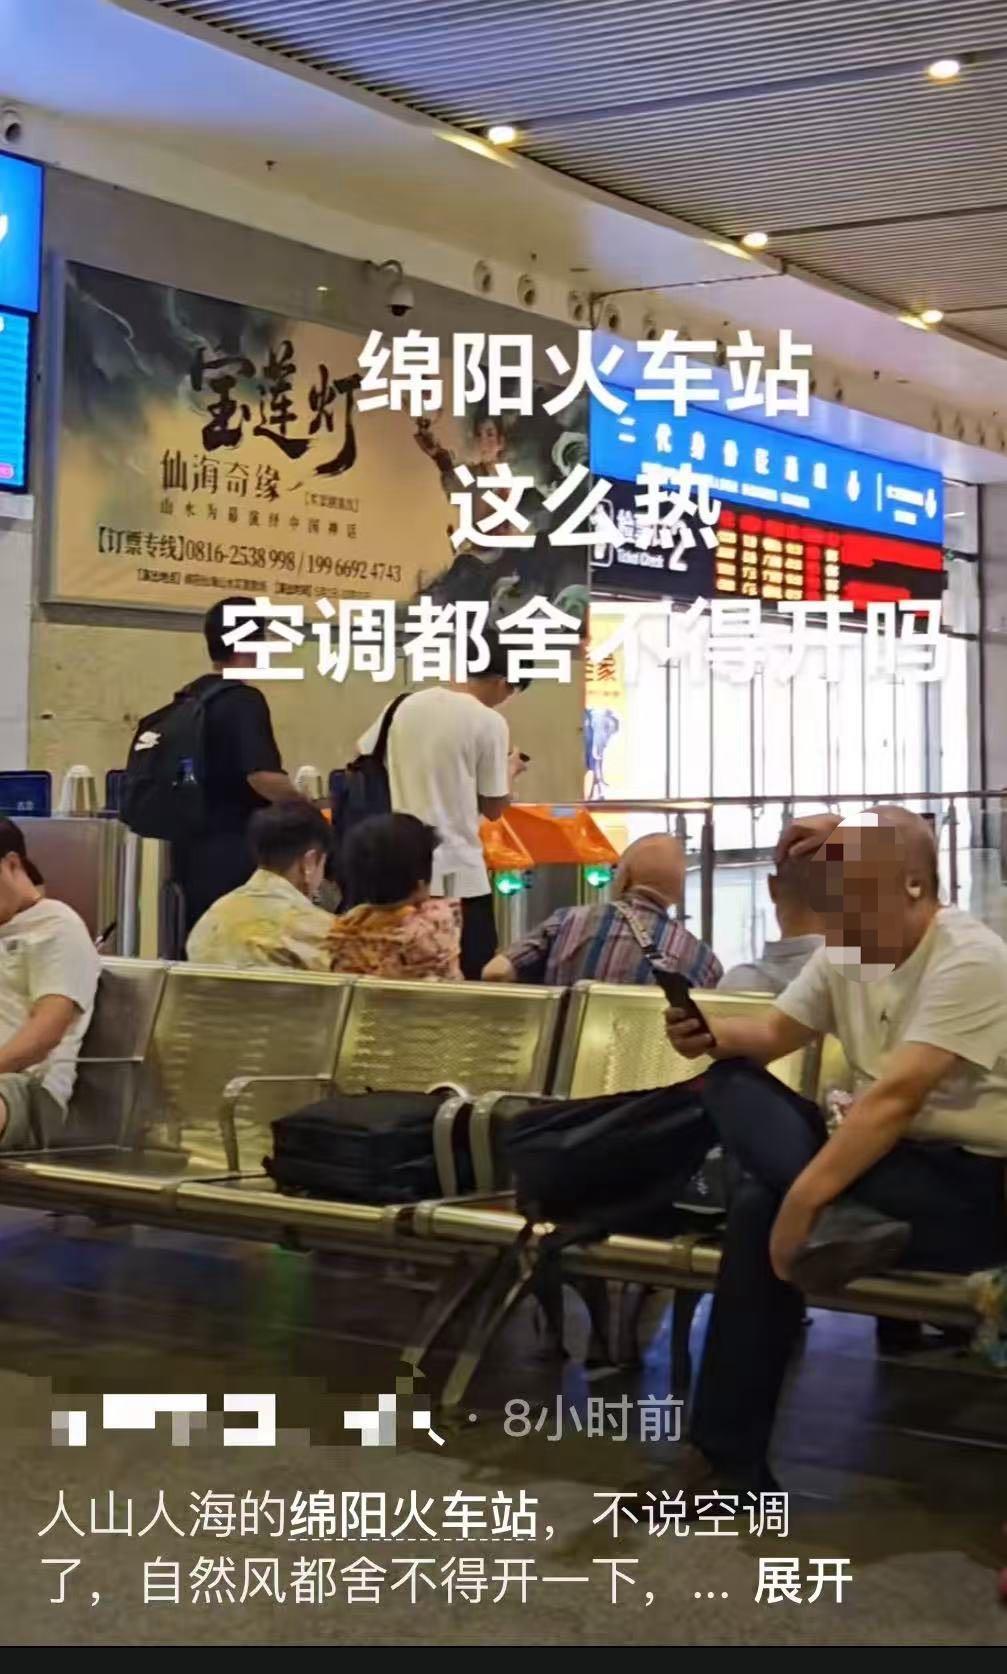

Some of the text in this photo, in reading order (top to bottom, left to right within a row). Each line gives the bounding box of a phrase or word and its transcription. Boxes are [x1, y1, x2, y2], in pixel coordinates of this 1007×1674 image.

[189, 340, 362, 477] 宝莲灯
[160, 448, 281, 503] 仙海奇缘
